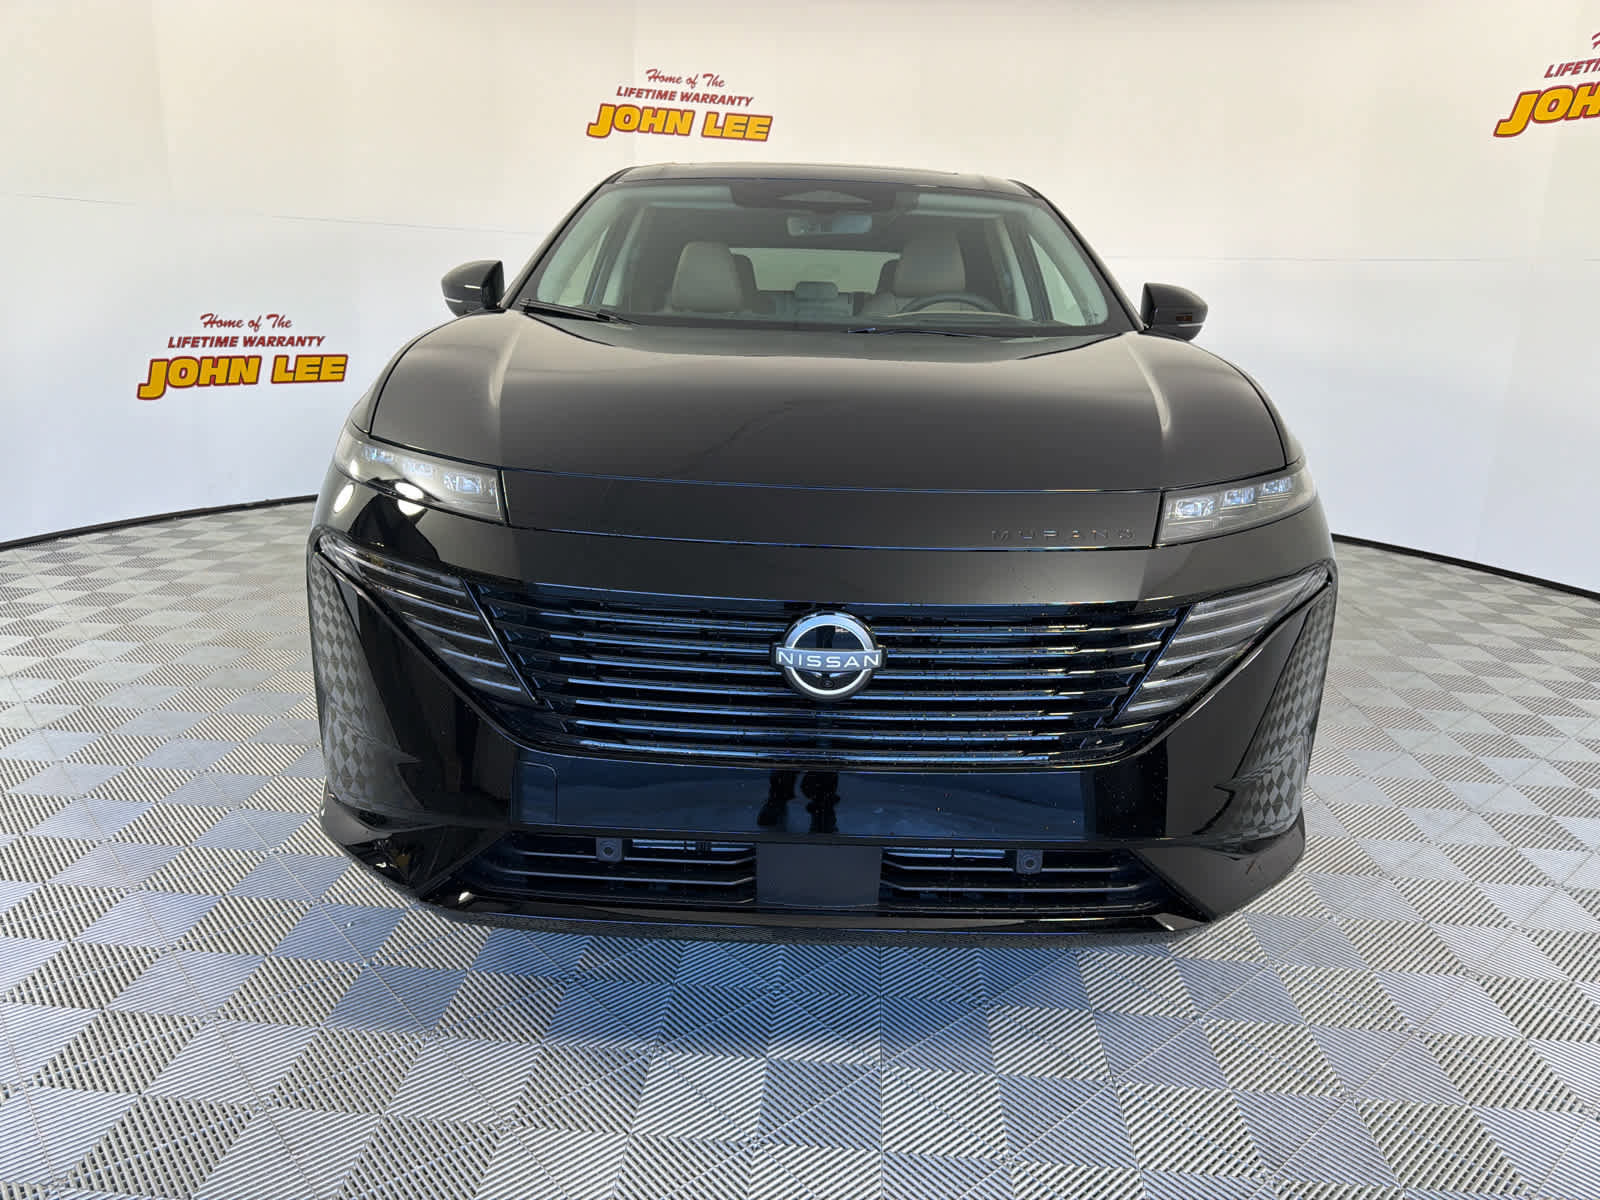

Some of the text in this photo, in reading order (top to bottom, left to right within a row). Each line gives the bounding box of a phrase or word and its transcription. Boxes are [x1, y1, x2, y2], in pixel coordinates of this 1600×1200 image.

[1543, 57, 1600, 78] LIFETI
[646, 68, 726, 89] Home of The
[616, 86, 755, 107] LIFETIME WARRANTY
[586, 103, 774, 142] JOHN LEE
[200, 313, 292, 332] Home of The
[167, 335, 326, 349] LIFETIME WARRANTY
[137, 354, 348, 400] JOHN LEE
[777, 650, 880, 668] NISSAN
